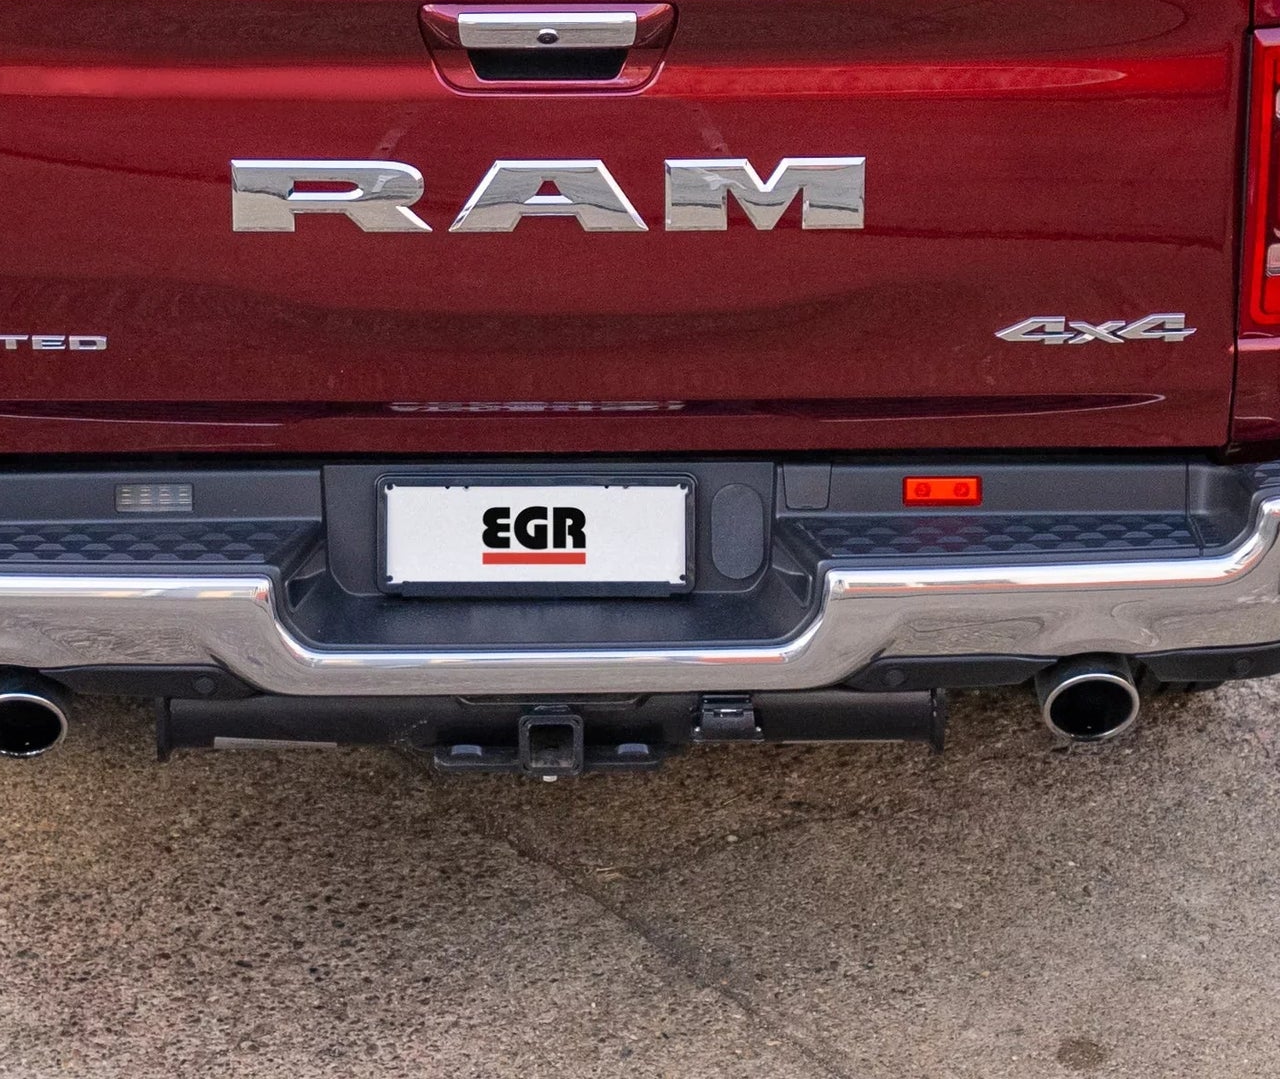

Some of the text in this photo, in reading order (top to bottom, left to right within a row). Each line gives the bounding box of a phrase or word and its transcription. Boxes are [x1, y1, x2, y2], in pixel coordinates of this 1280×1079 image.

[230, 156, 866, 232] RAM
[994, 312, 1197, 345] 4x4
[482, 506, 586, 550] EGR
